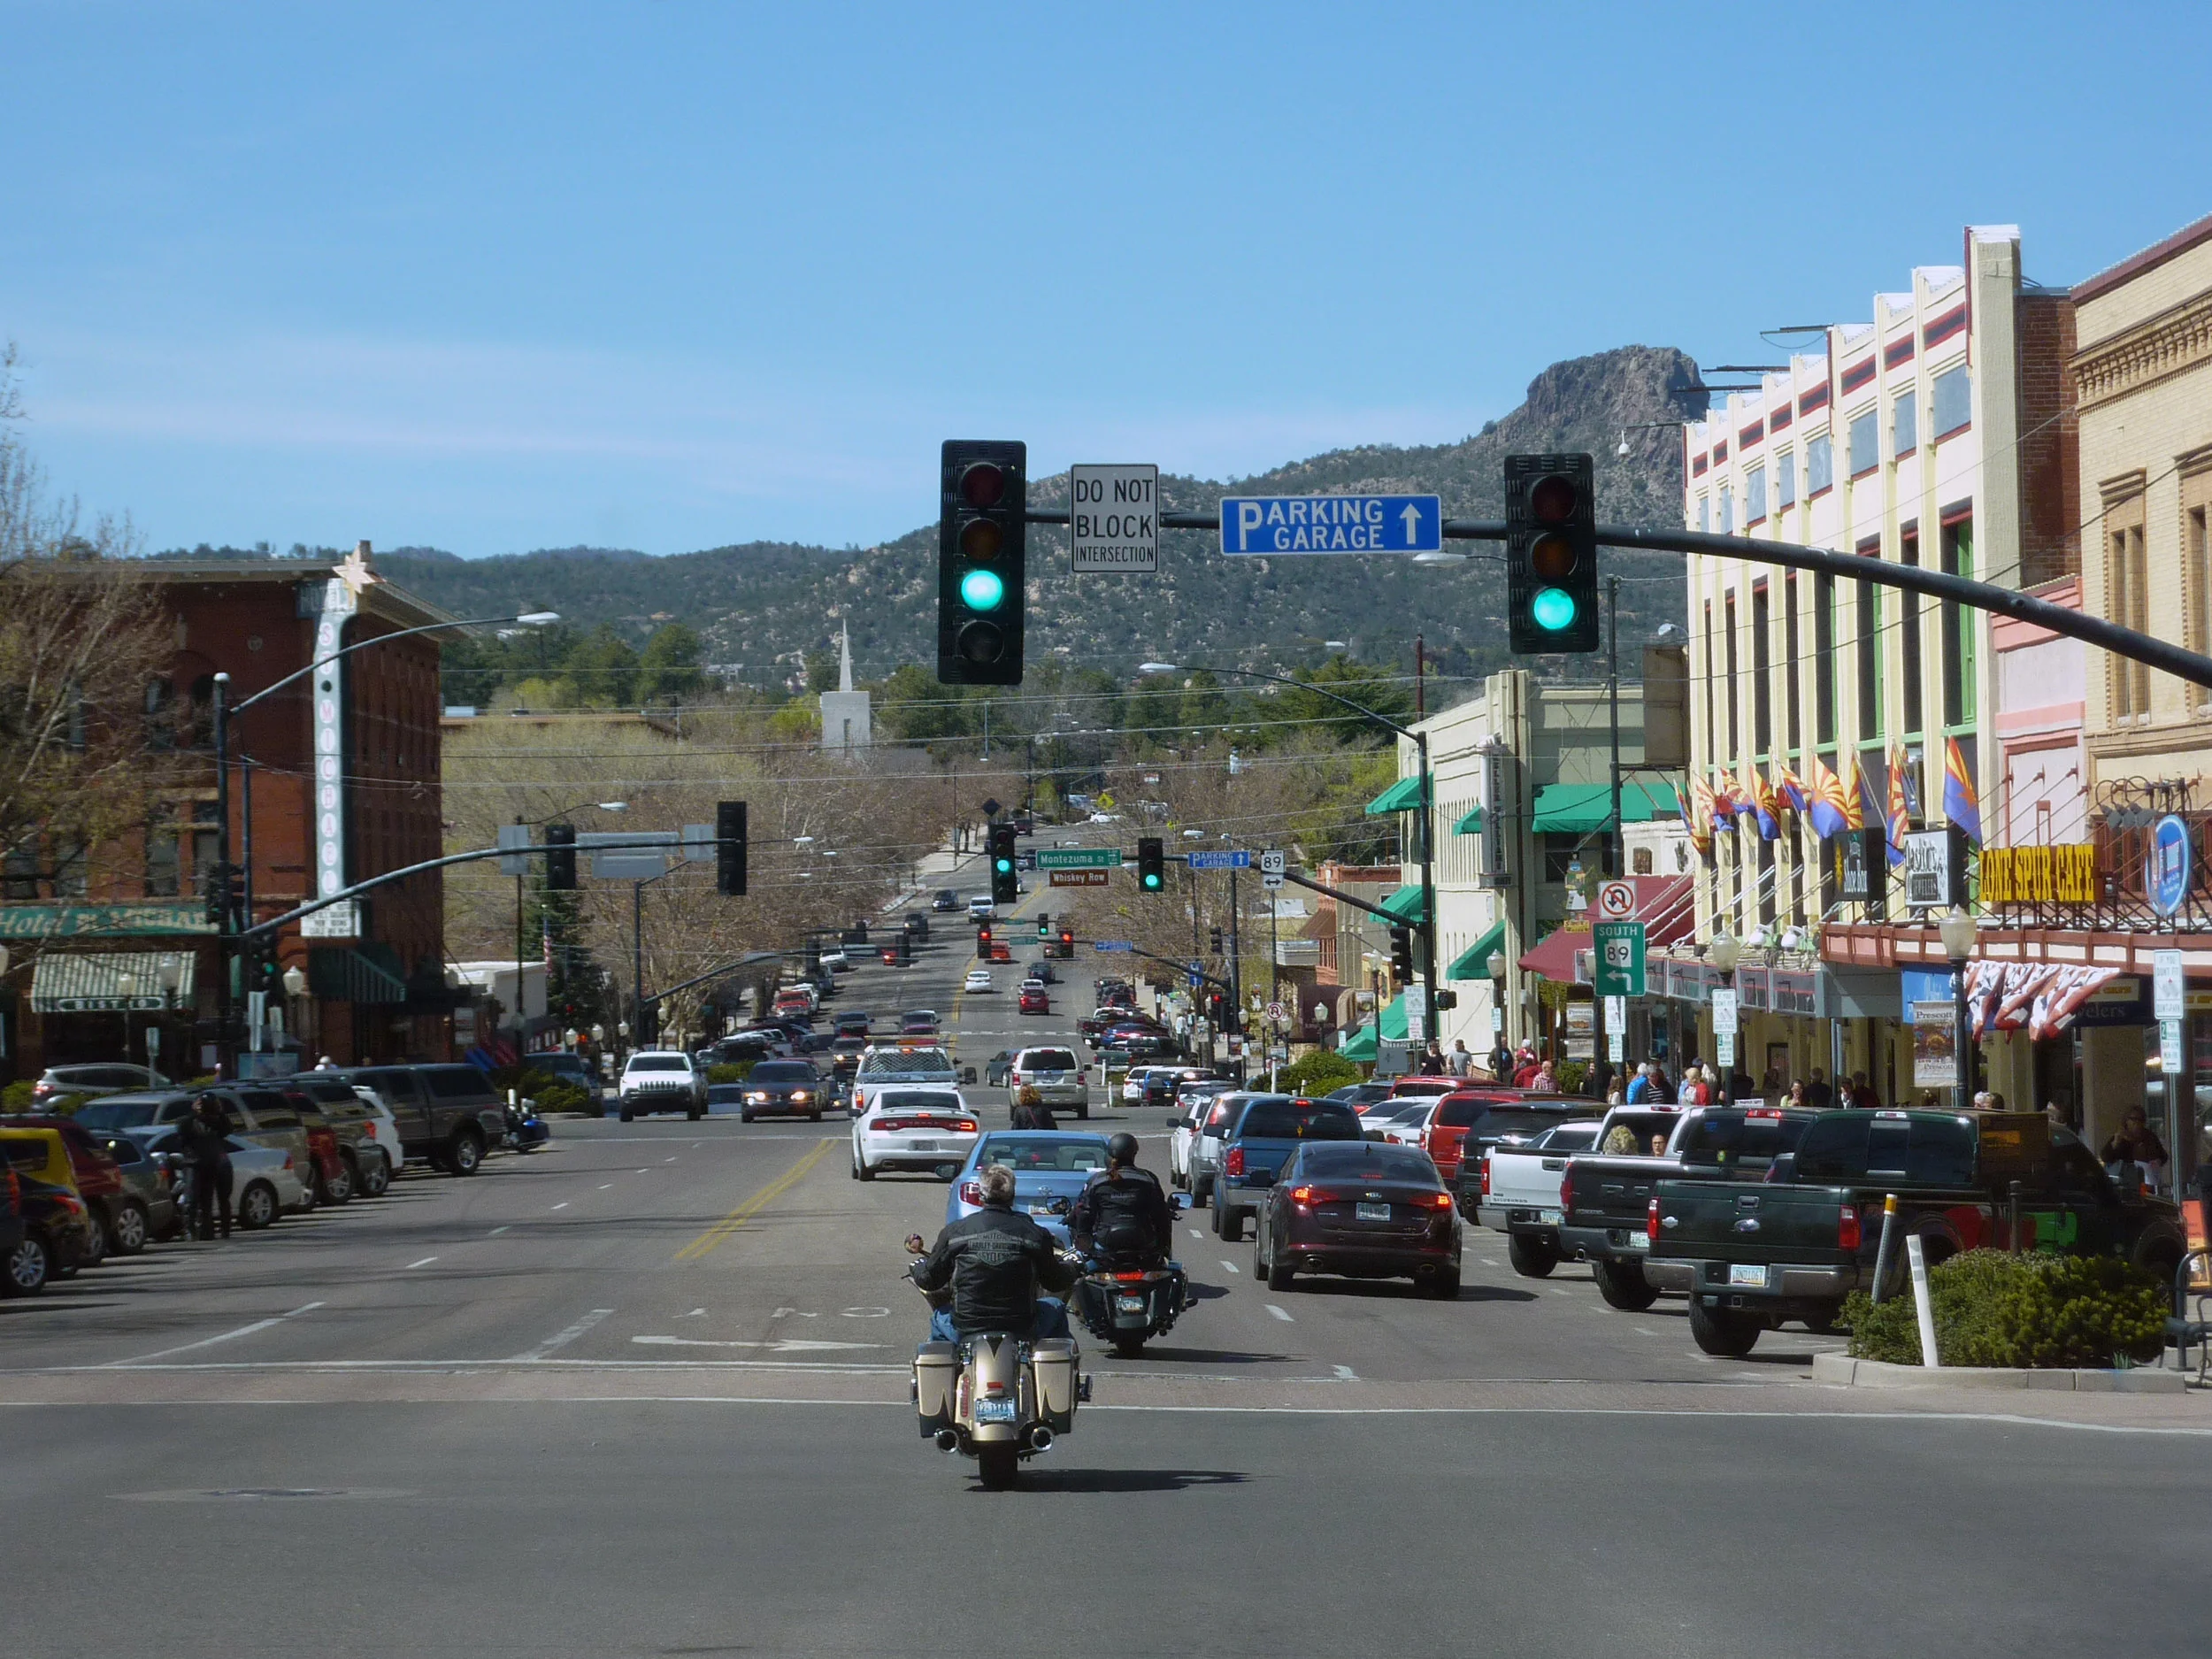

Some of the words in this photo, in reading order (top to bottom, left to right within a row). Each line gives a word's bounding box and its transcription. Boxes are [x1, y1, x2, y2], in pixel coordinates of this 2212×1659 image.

[1076, 479, 1103, 503] DO
[1114, 479, 1154, 503] NOT
[1075, 515, 1154, 539] BLOCK
[1239, 499, 1384, 551] PARKING
[1273, 525, 1385, 550] GARAGE
[1075, 546, 1154, 563] INTERSECTION
[1041, 854, 1093, 864] Montezuma
[1194, 852, 1233, 867] PARKING
[1263, 856, 1281, 868] 89
[1053, 872, 1086, 883] Whiskey
[1088, 872, 1105, 881] Row
[1978, 847, 2012, 902] LONE
[2015, 845, 2053, 902] SPUR
[2055, 843, 2094, 902] CAFE
[1599, 926, 1638, 936] SOUTH
[1607, 946, 1629, 961] 89
[74, 1000, 148, 1010] BISTO
